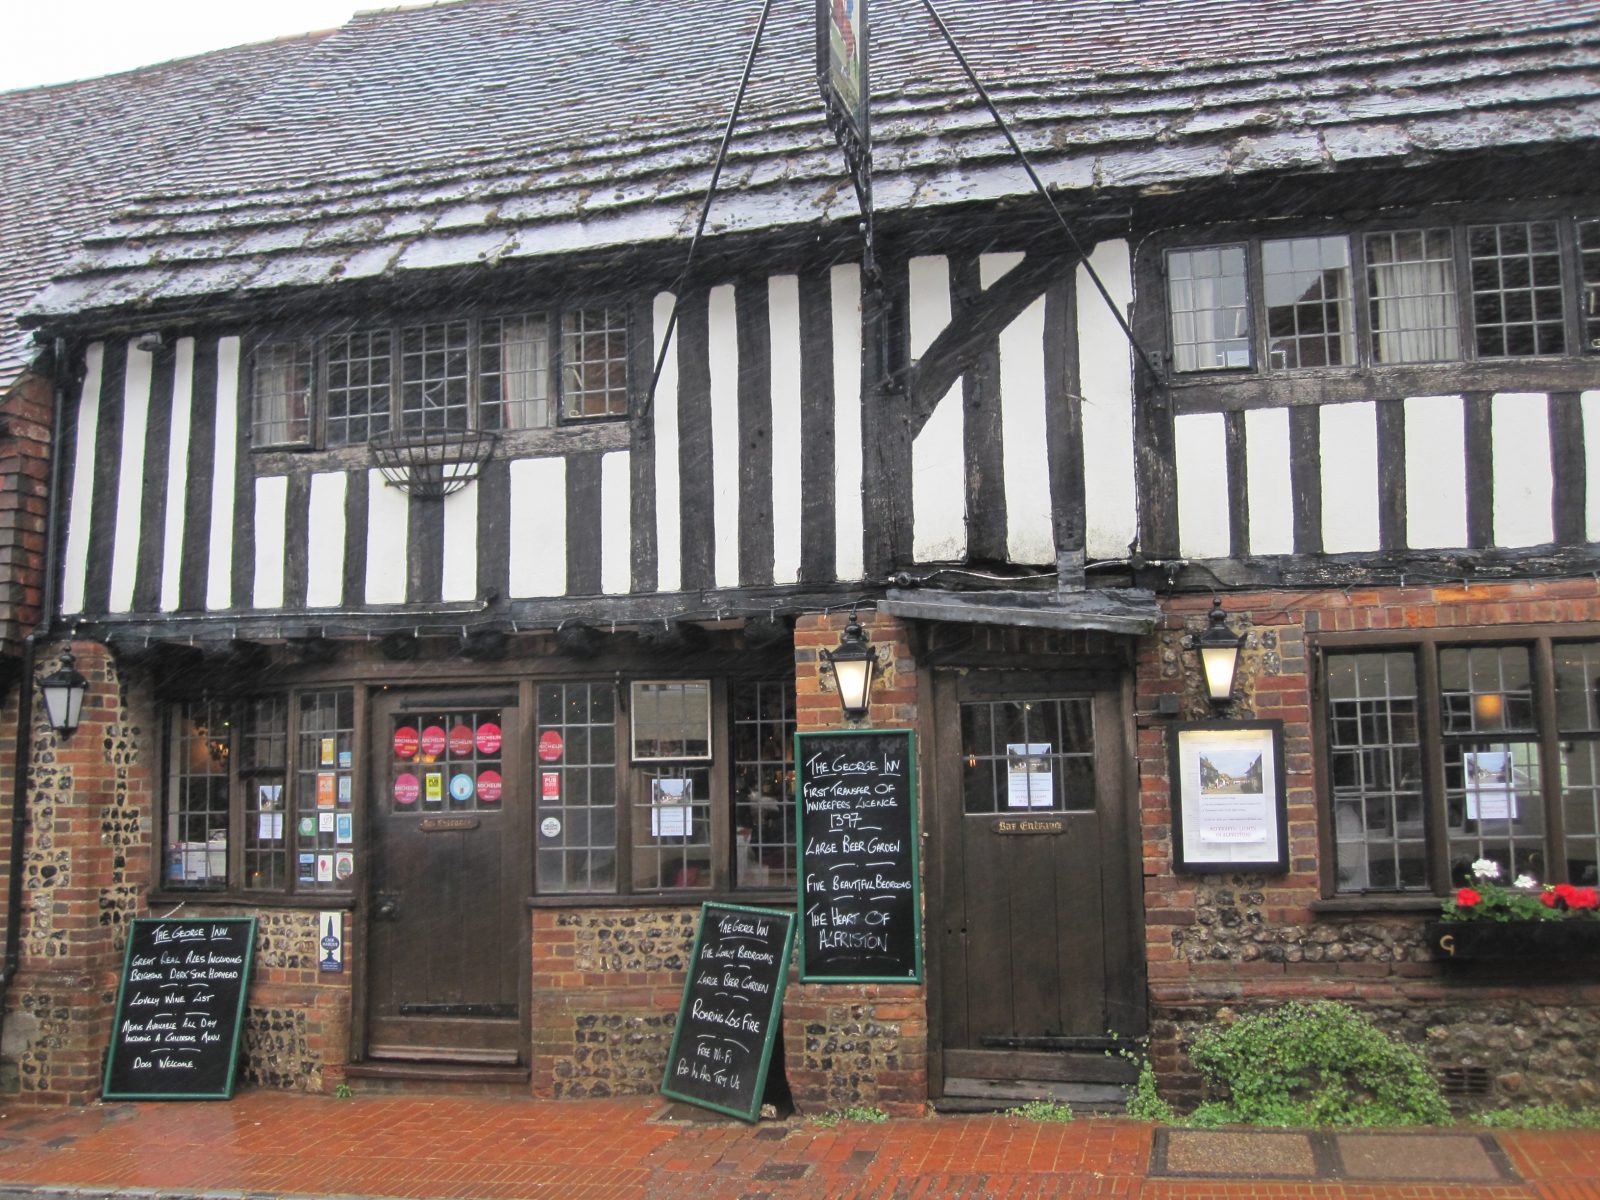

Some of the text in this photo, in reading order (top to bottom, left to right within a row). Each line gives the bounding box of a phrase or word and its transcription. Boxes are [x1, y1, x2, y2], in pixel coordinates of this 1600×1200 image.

[806, 752, 900, 775] THE GEORGE INN
[804, 780, 896, 798] FIRST TRANSFER OF
[805, 797, 898, 815] INNKEEPERS LICENCE
[830, 812, 862, 829] 1397
[999, 820, 1062, 831] Bar Entrance
[805, 835, 900, 856] LARGE BEER GARDEN
[806, 873, 912, 893] FIVE BEAUTIFUL BEDROOMS
[806, 902, 891, 927] THE HEART OF
[152, 924, 228, 942] THE GEORGE INN
[718, 914, 769, 936] THE GEORGE INN
[819, 928, 889, 952] ALFRISTON
[132, 950, 242, 967] GREAT REAL ALES INCLUDING
[737, 944, 774, 965] BEDROOMS
[170, 968, 189, 979] DARK
[190, 969, 207, 979] STAR
[697, 970, 769, 994] LARGE BEER GARDEN
[130, 992, 215, 1006] LOVELY WINE LIST
[122, 1018, 217, 1033] MENUS AVAILABLE ALL DAY
[725, 1009, 740, 1028] LOG
[155, 1033, 161, 1042] A
[697, 1042, 711, 1058] FREE
[133, 1057, 152, 1069] DOGS
[677, 1058, 689, 1076] POP
[713, 1068, 728, 1087] TRY
